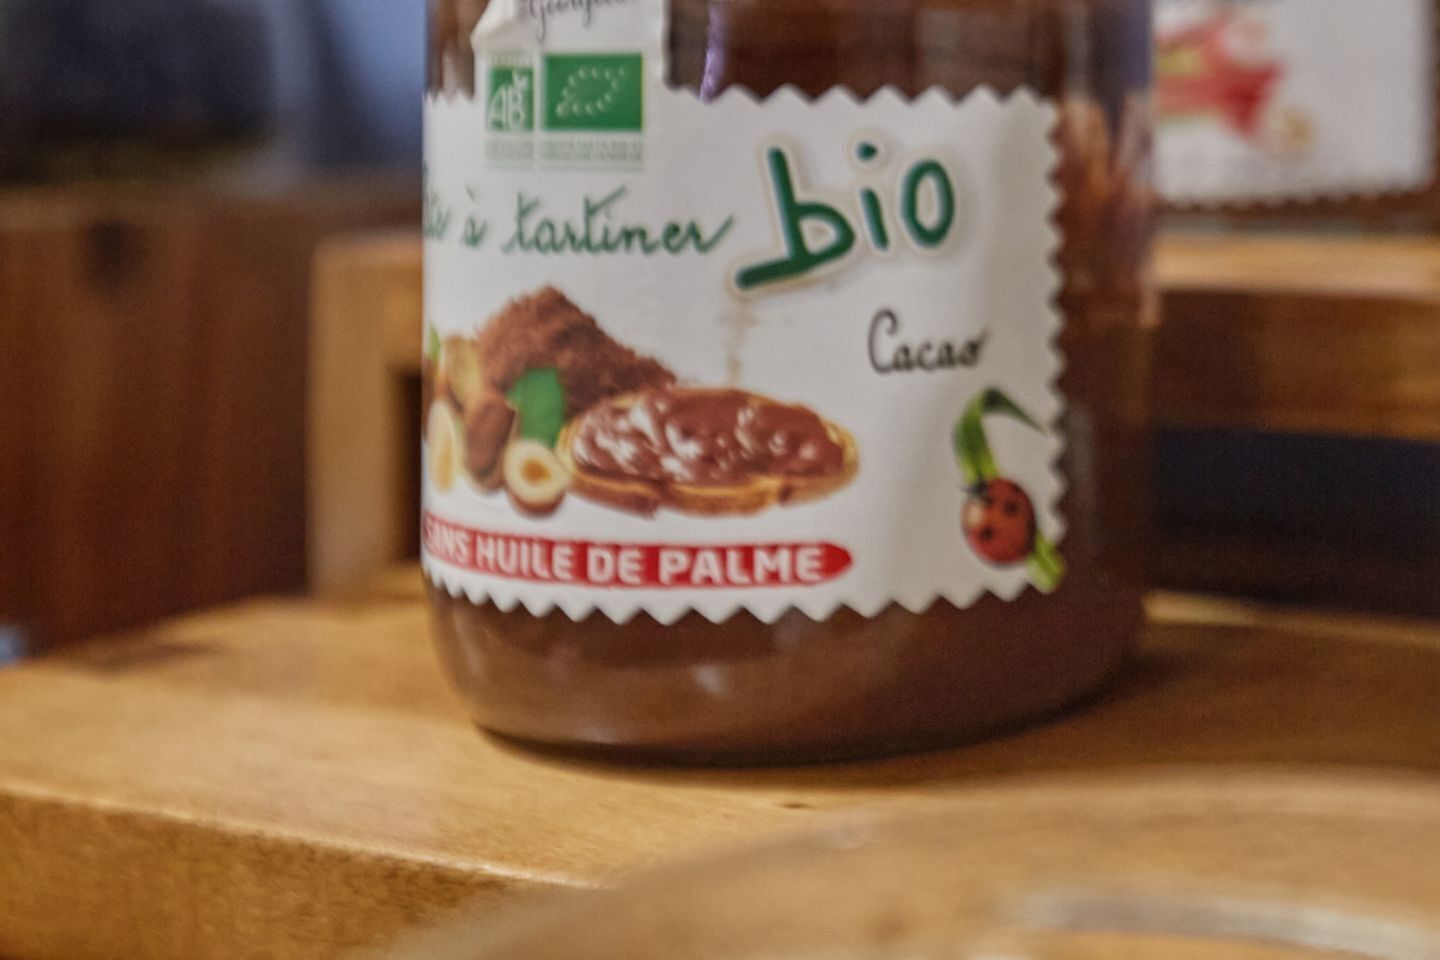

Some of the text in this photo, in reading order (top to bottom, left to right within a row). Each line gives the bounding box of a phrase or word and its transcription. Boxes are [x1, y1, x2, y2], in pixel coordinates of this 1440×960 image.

[502, 187, 732, 254] tartiner
[736, 142, 955, 290] bio
[867, 307, 990, 375] Cacao
[475, 539, 573, 581] HUILE
[586, 547, 641, 585] DE
[658, 546, 824, 585] PALME
